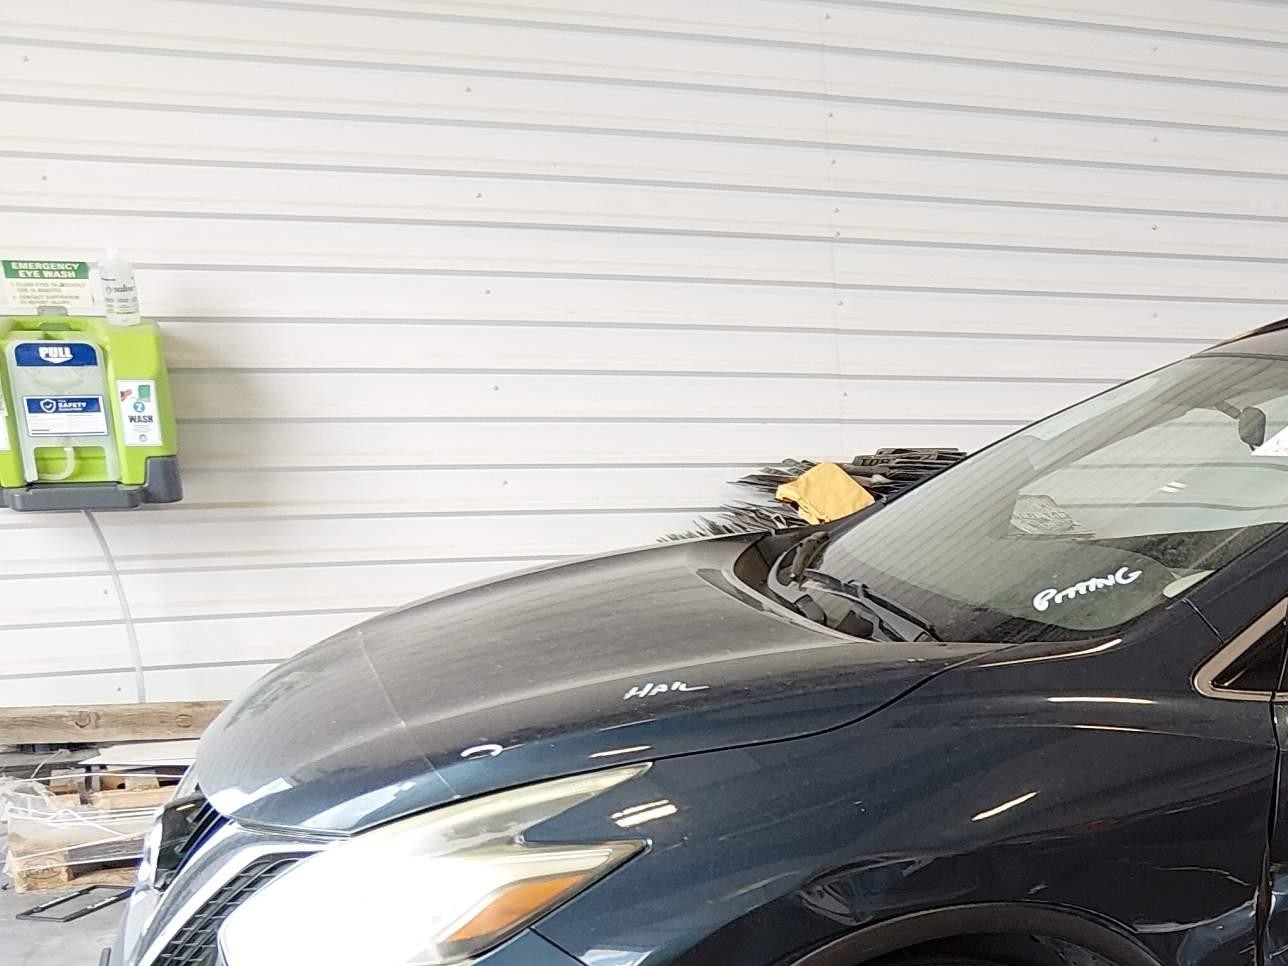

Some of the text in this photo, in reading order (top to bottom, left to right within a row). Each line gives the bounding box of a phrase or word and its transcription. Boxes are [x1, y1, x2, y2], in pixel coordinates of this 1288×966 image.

[11, 262, 80, 270] EMERGENCY
[18, 270, 76, 278] EYE WASH
[38, 346, 74, 358] PULL
[128, 415, 154, 423] WASH
